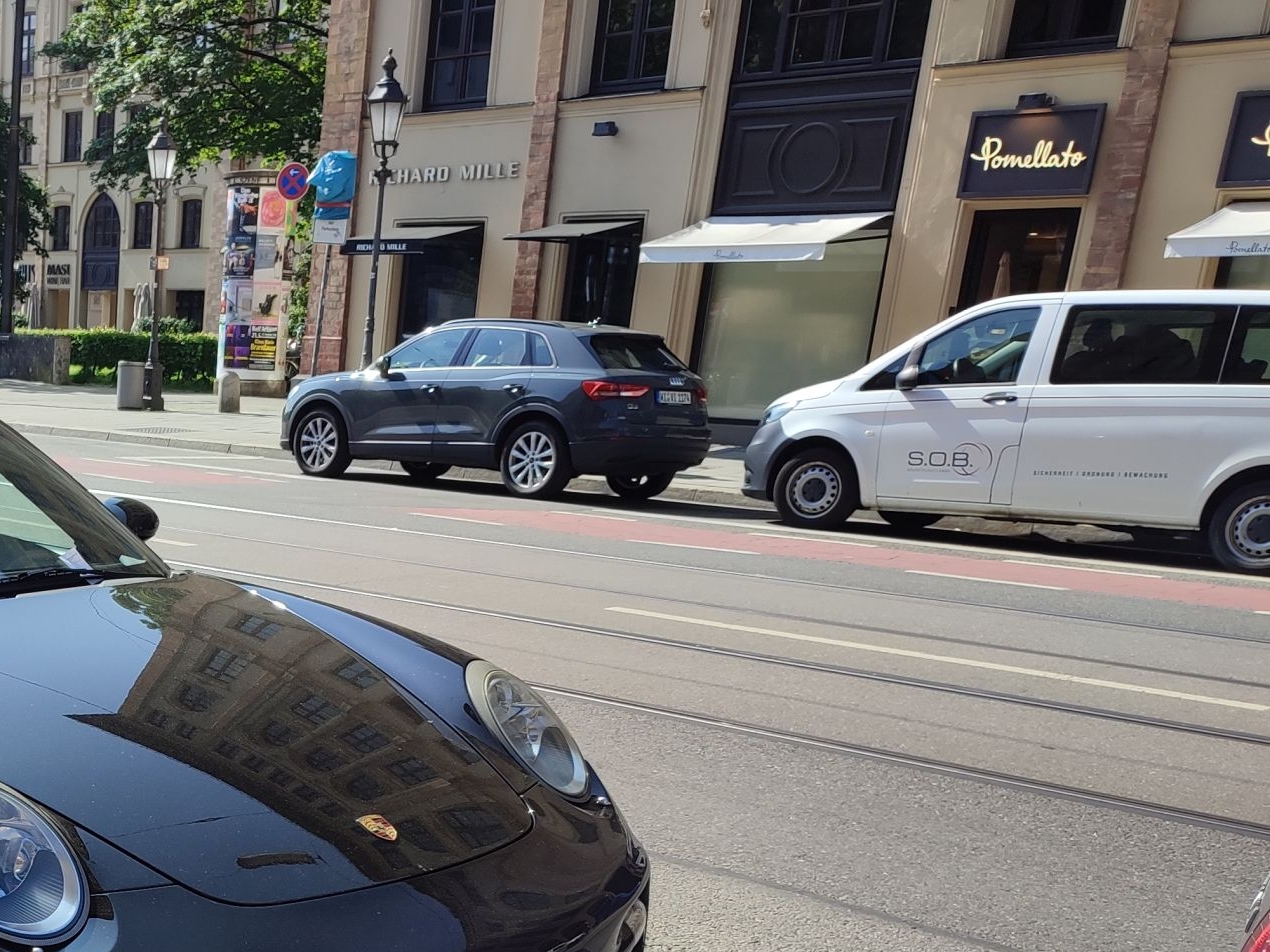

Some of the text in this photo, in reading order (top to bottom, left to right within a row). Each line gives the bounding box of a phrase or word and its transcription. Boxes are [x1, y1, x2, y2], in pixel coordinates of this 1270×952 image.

[970, 136, 1087, 171] Pomellato
[368, 161, 520, 185] RCHARD MILLE
[908, 451, 973, 467] S.O.B.
